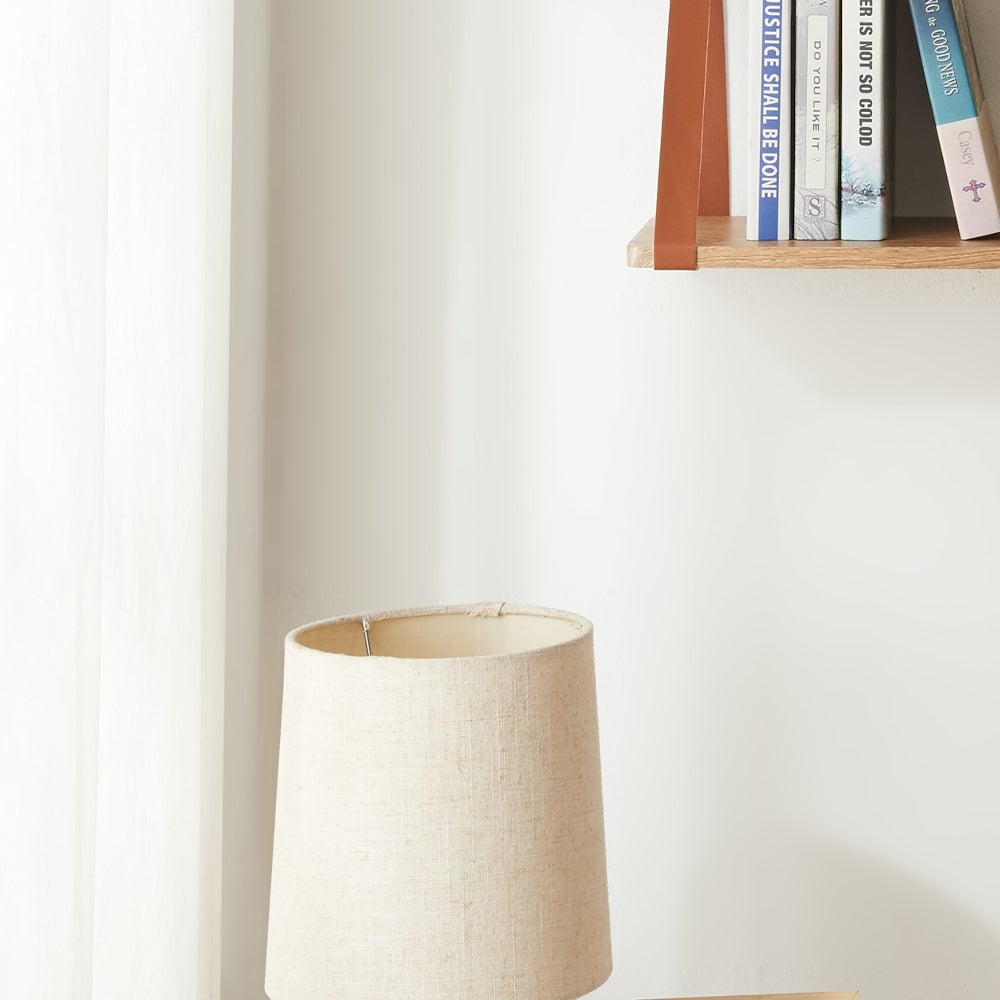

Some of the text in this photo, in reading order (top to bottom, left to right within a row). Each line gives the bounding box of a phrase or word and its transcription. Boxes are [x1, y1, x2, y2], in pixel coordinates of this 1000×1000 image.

[859, 21, 873, 36] IS
[927, 16, 938, 27] the
[813, 41, 822, 60] DO
[859, 41, 873, 70] NOT
[931, 29, 951, 63] GOOD
[812, 67, 821, 95] YOU
[859, 74, 873, 94] SO
[938, 63, 959, 96] NEWS
[762, 73, 780, 124] SHALL
[811, 100, 821, 132] LIKE
[858, 98, 873, 147] COLOD
[762, 128, 779, 148] BE
[811, 137, 820, 150] IT
[957, 130, 975, 166] Casey
[761, 152, 778, 198] DONE
